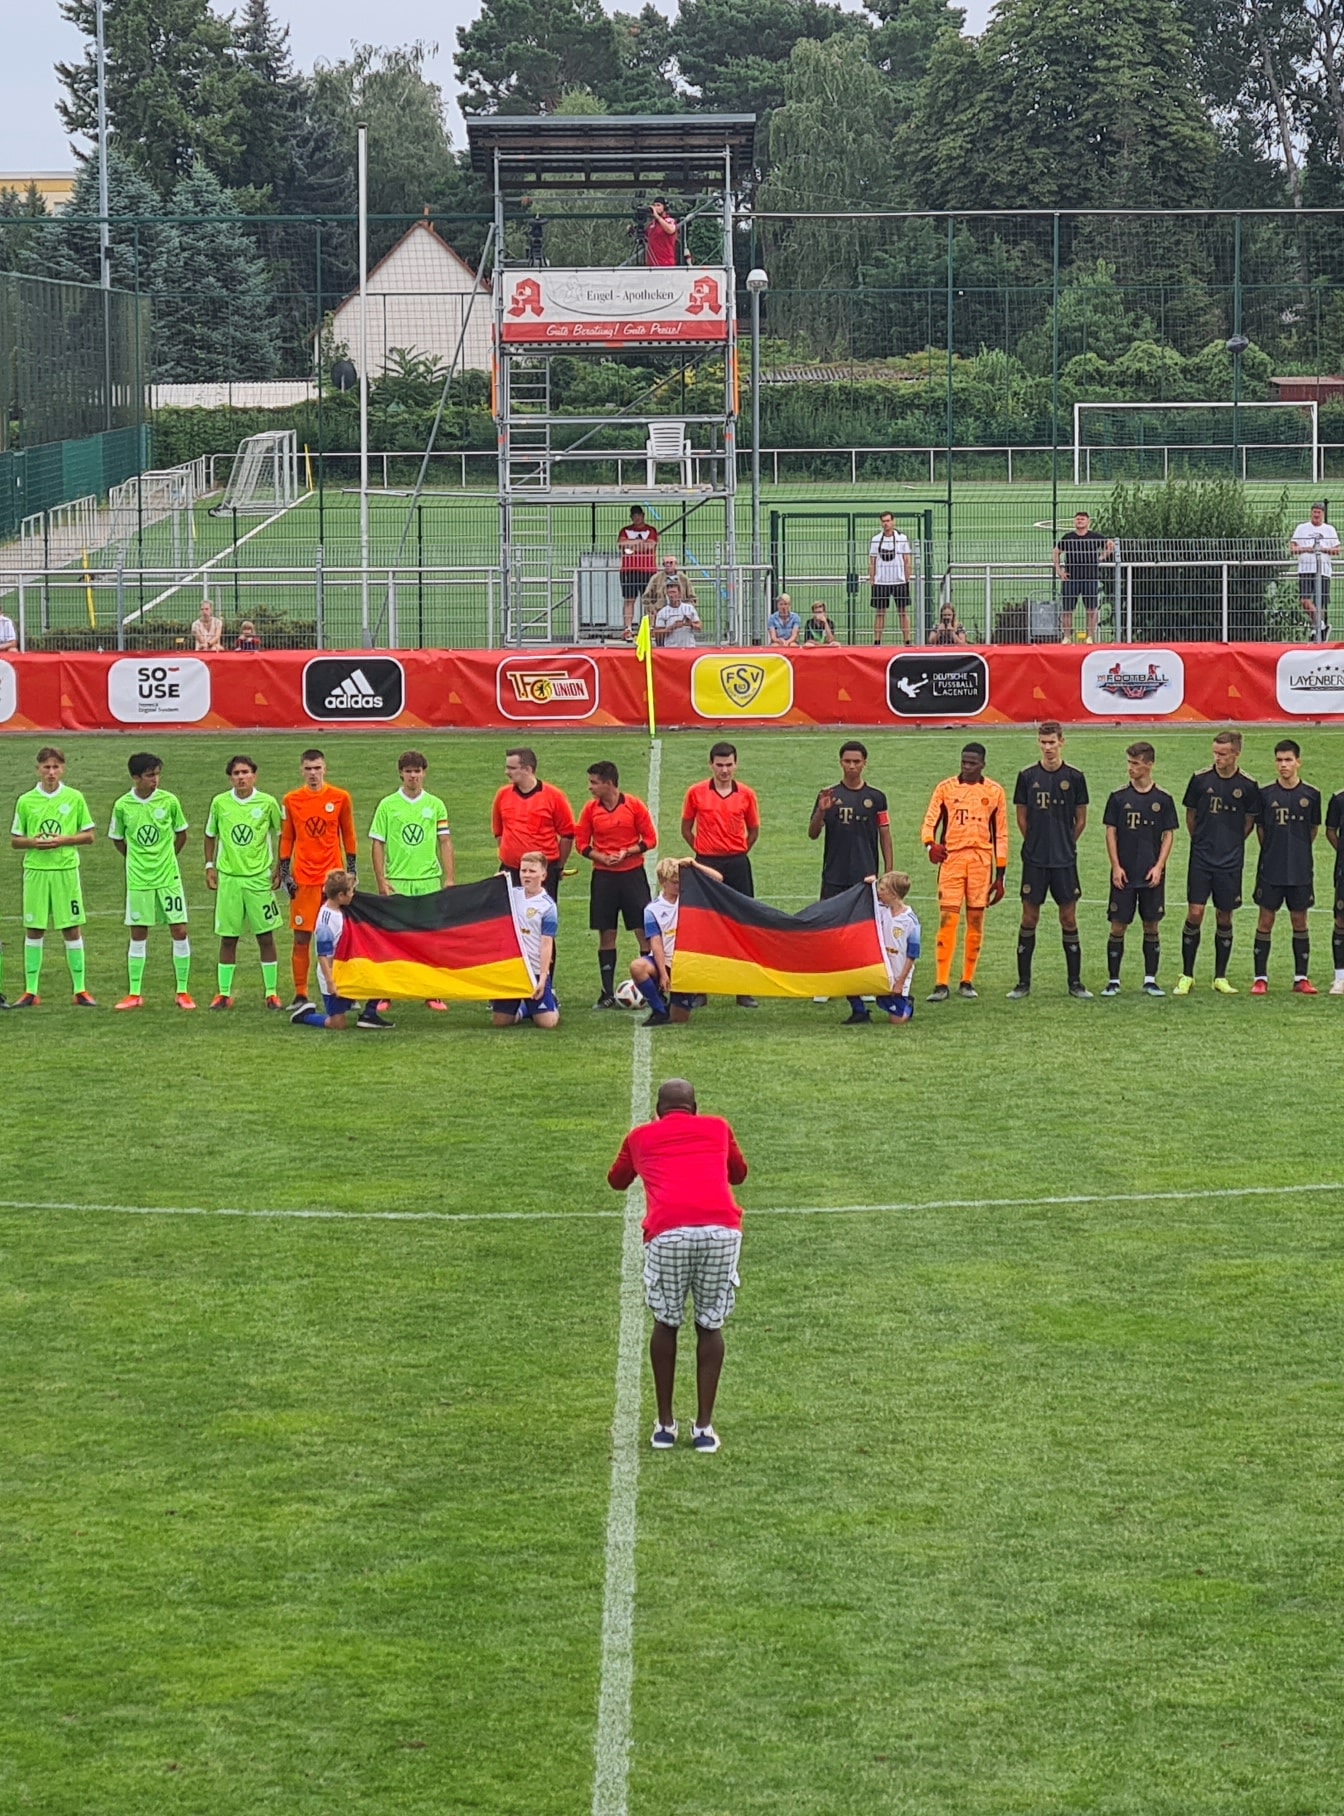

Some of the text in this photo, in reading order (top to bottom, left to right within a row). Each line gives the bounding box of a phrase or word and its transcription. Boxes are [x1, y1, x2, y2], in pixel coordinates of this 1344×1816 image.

[586, 290, 614, 303] Engel
[623, 289, 674, 302] Apotheken
[573, 324, 619, 338] Beratung!
[138, 667, 167, 682] SO
[1107, 674, 1168, 682] FOOTBALL
[139, 684, 180, 698] USE
[553, 682, 585, 696] UNION
[324, 694, 383, 708] adidas
[71, 900, 80, 915] 6
[165, 896, 182, 912] 30
[262, 901, 279, 920] 20
